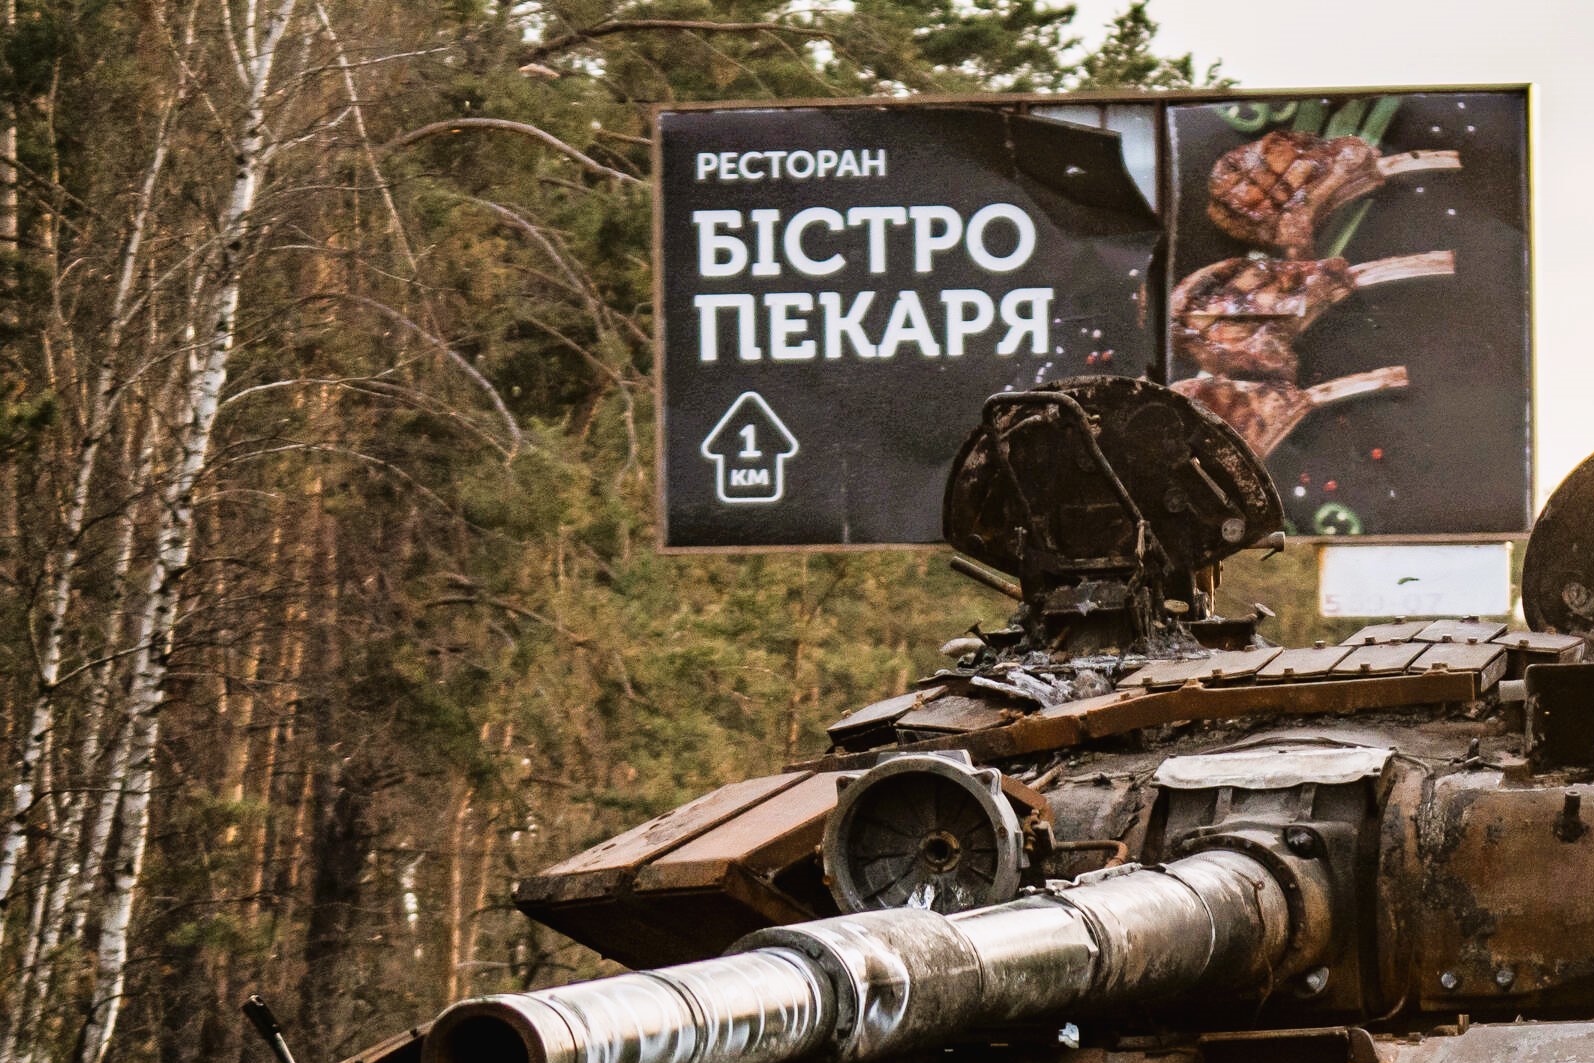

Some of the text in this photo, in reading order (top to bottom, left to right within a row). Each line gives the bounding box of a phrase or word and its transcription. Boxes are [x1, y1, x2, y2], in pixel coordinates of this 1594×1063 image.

[697, 149, 887, 180] РЕСТОРАН
[693, 203, 1037, 277] БІСТРО
[694, 288, 1054, 362] ПЕКАРЯ
[739, 424, 762, 458] 1
[731, 469, 769, 486] КМ
